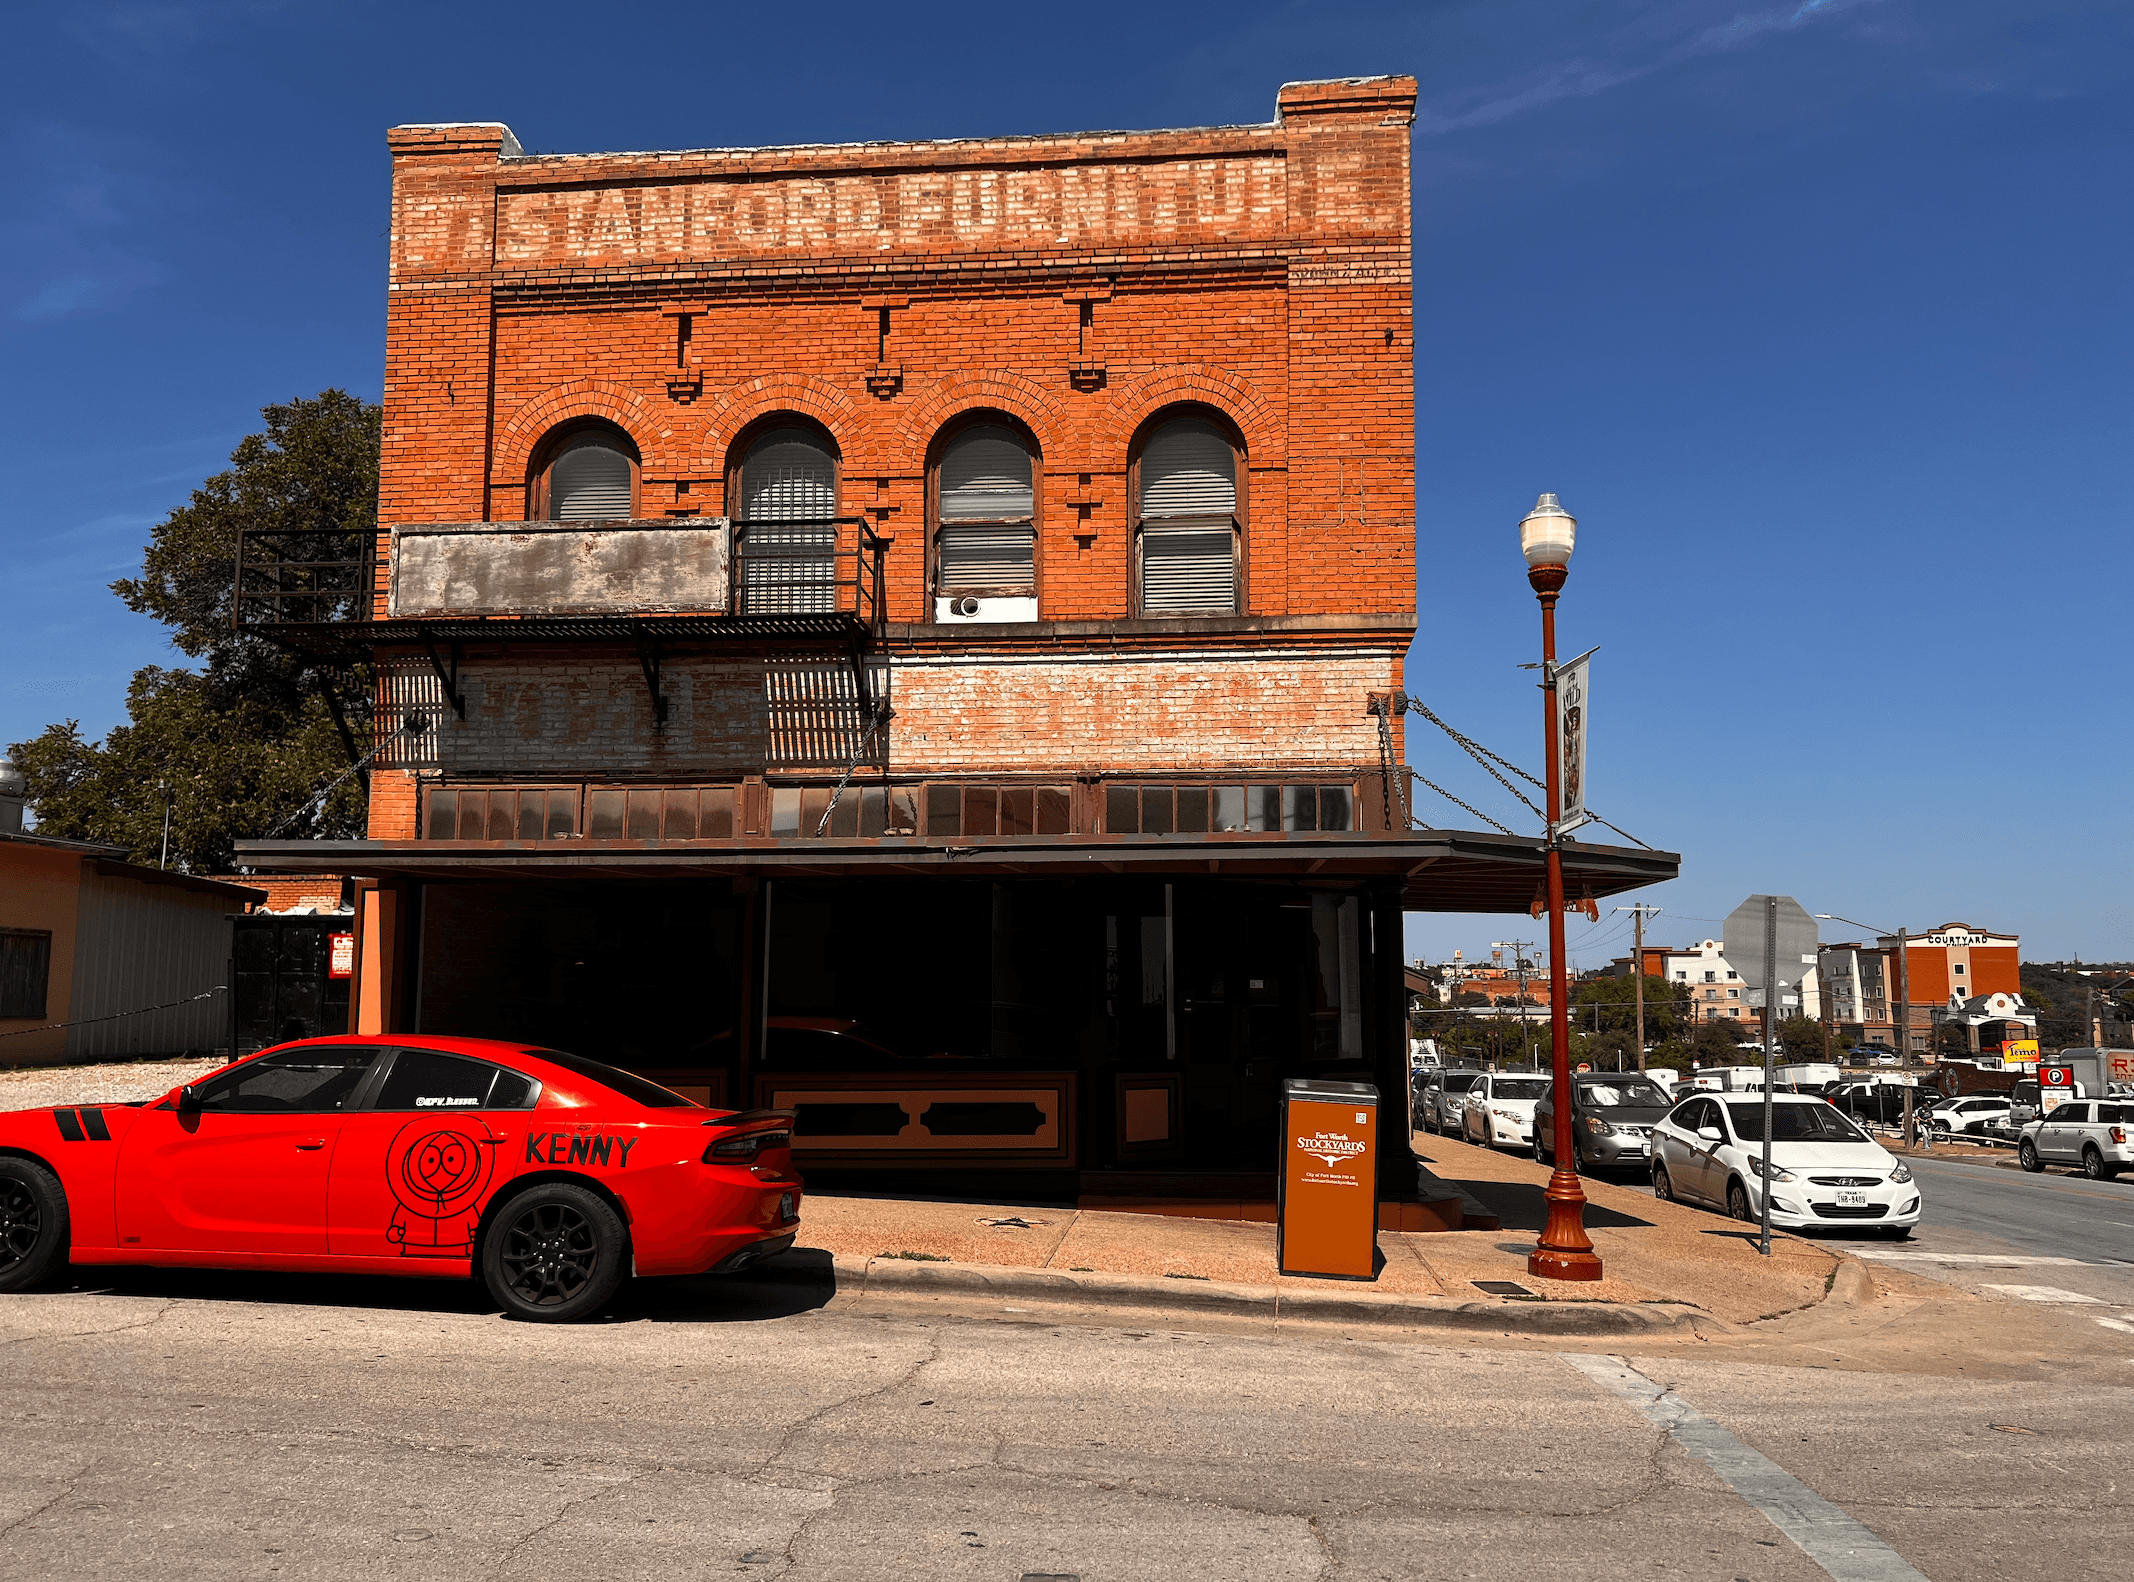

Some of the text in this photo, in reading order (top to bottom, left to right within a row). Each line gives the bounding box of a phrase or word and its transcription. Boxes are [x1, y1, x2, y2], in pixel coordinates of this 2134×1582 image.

[1928, 936, 1987, 944] COURTYARD
[1315, 1131, 1348, 1141] Fort Worth
[525, 1132, 639, 1168] KENNY
[1297, 1136, 1366, 1153] STOCKYARDS
